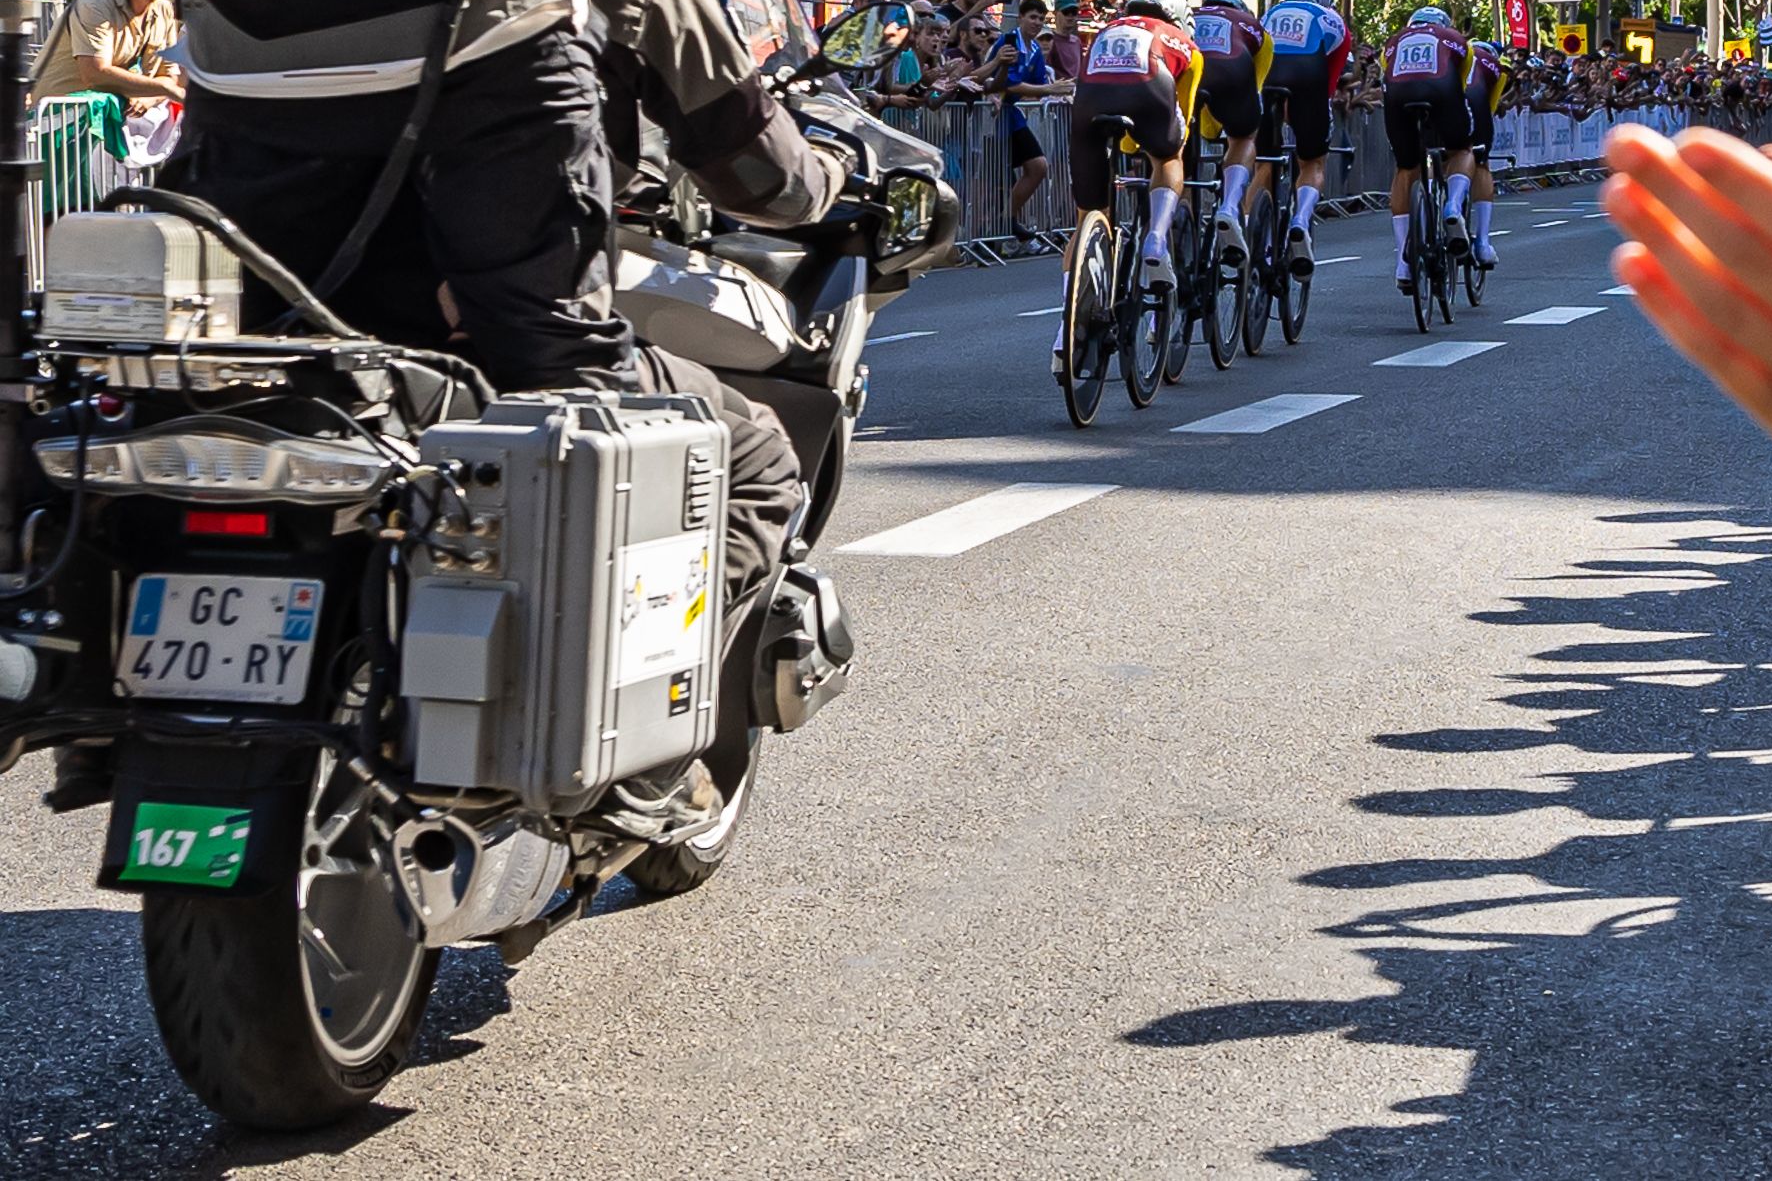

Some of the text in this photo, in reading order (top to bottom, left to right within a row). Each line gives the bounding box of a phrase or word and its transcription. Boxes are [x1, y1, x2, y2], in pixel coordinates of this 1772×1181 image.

[1270, 17, 1304, 34] 166
[1098, 37, 1138, 59] 161
[1401, 46, 1431, 62] 164
[189, 585, 244, 627] GC
[135, 828, 199, 868] 167
